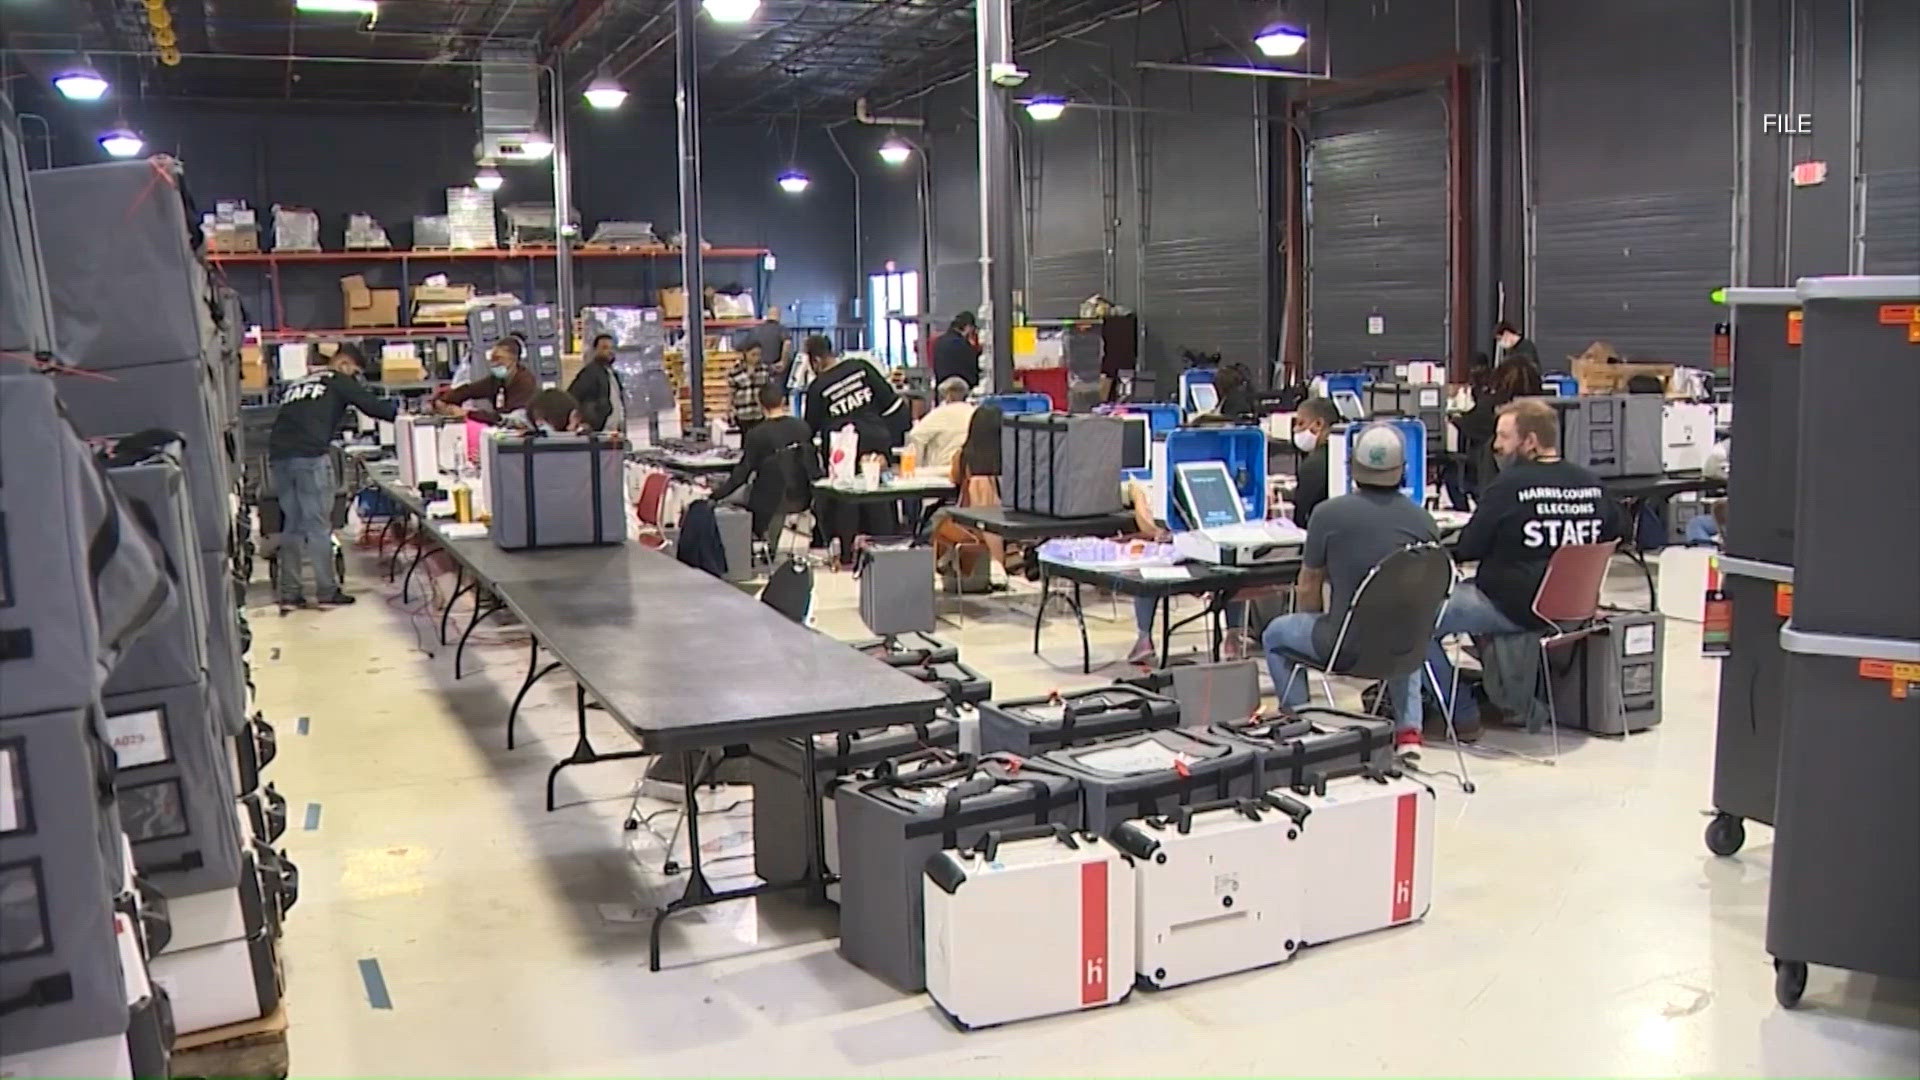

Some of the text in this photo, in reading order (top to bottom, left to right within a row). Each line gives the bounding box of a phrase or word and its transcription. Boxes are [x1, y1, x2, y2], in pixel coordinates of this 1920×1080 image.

[281, 383, 327, 404] TAFF
[829, 386, 873, 417] STAFF
[1518, 487, 1561, 502] HARRIS
[1536, 503, 1595, 515] ELECTIONS
[1523, 519, 1602, 547] STAFF
